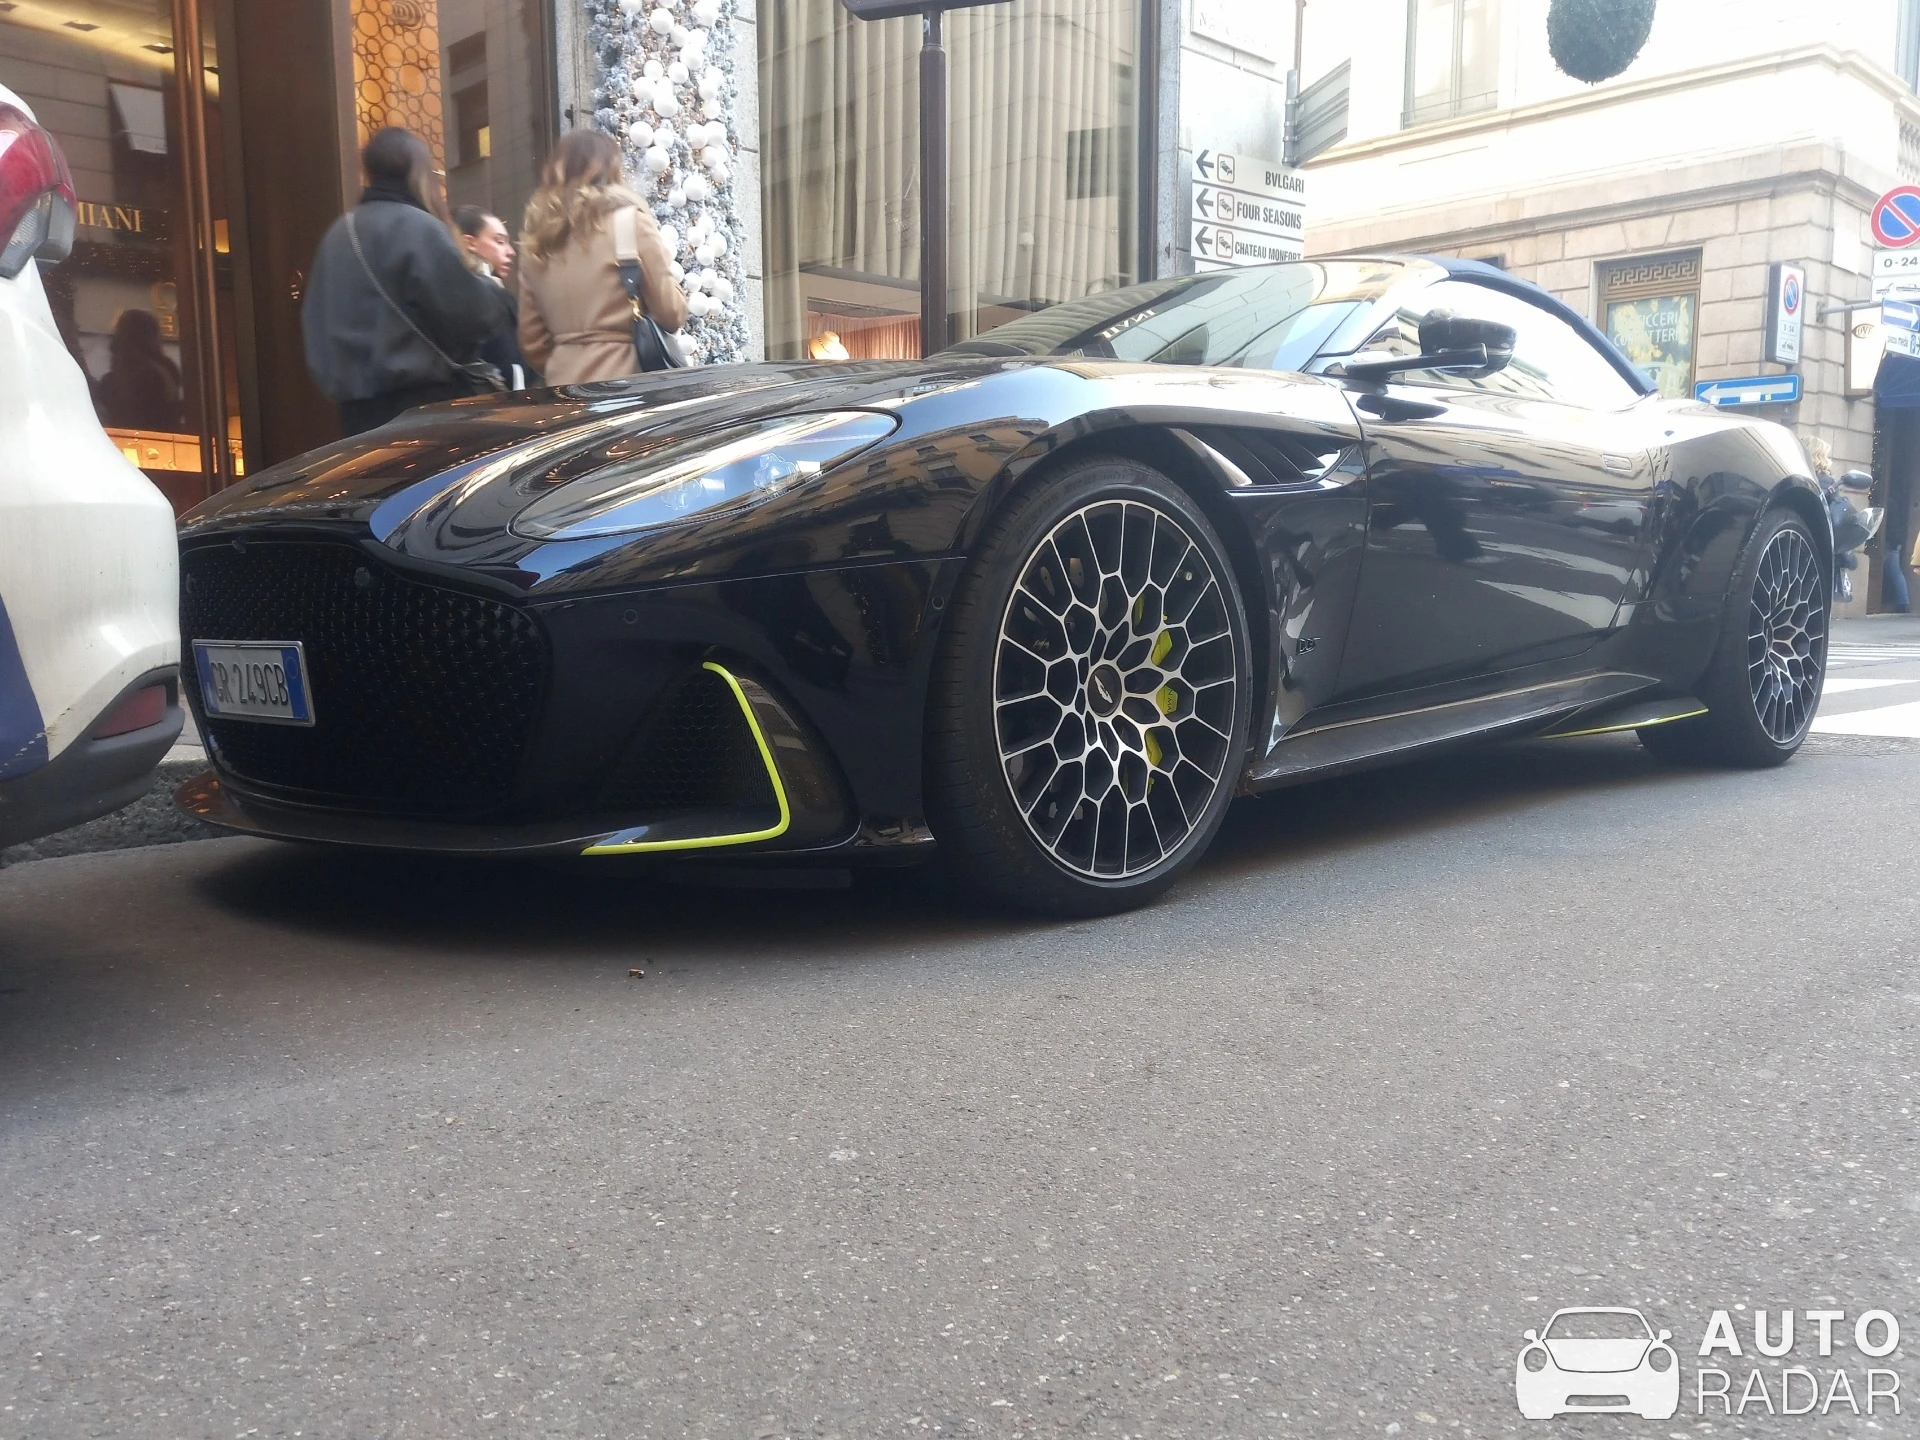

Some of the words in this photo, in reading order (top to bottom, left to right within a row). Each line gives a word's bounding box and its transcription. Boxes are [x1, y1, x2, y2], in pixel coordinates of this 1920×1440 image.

[1265, 171, 1304, 193] BVLGARI
[1237, 201, 1260, 221] FOUR
[1263, 207, 1301, 229] SEASONS
[1235, 241, 1266, 259] CHATEAU
[210, 662, 235, 704] GR
[233, 663, 288, 705] 249CB
